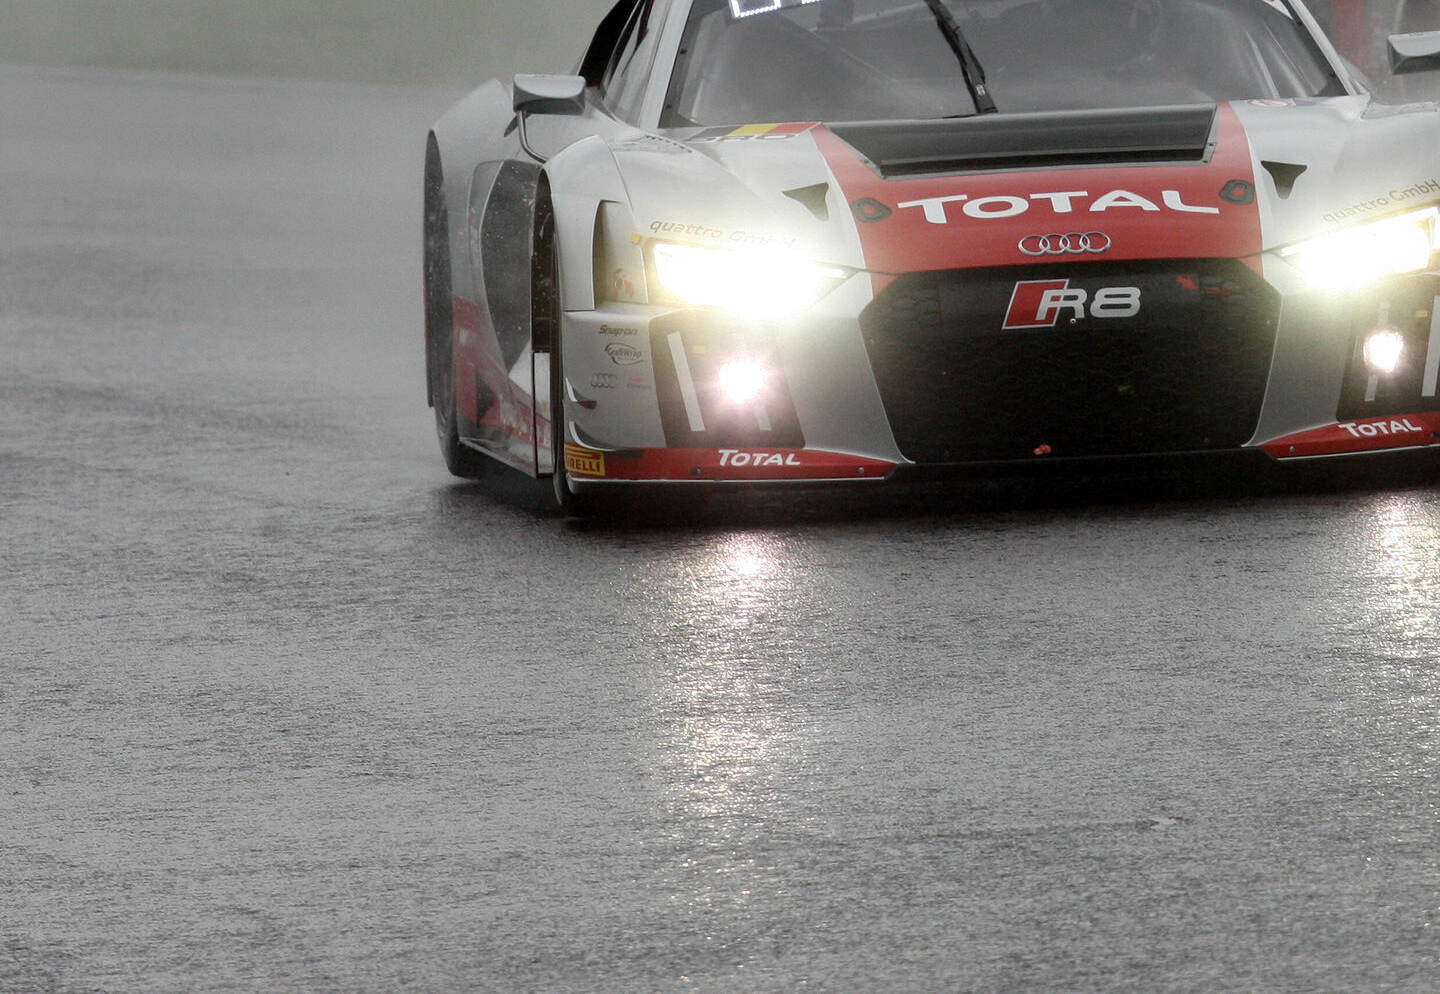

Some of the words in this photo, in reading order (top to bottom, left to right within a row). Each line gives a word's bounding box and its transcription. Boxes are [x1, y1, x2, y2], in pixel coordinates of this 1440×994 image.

[897, 189, 1220, 225] TOTAL
[1322, 196, 1389, 224] quattro
[650, 220, 722, 239] quattro
[1034, 286, 1141, 322] R8
[1338, 418, 1423, 438] TOTAL
[718, 448, 801, 468] TOTAL
